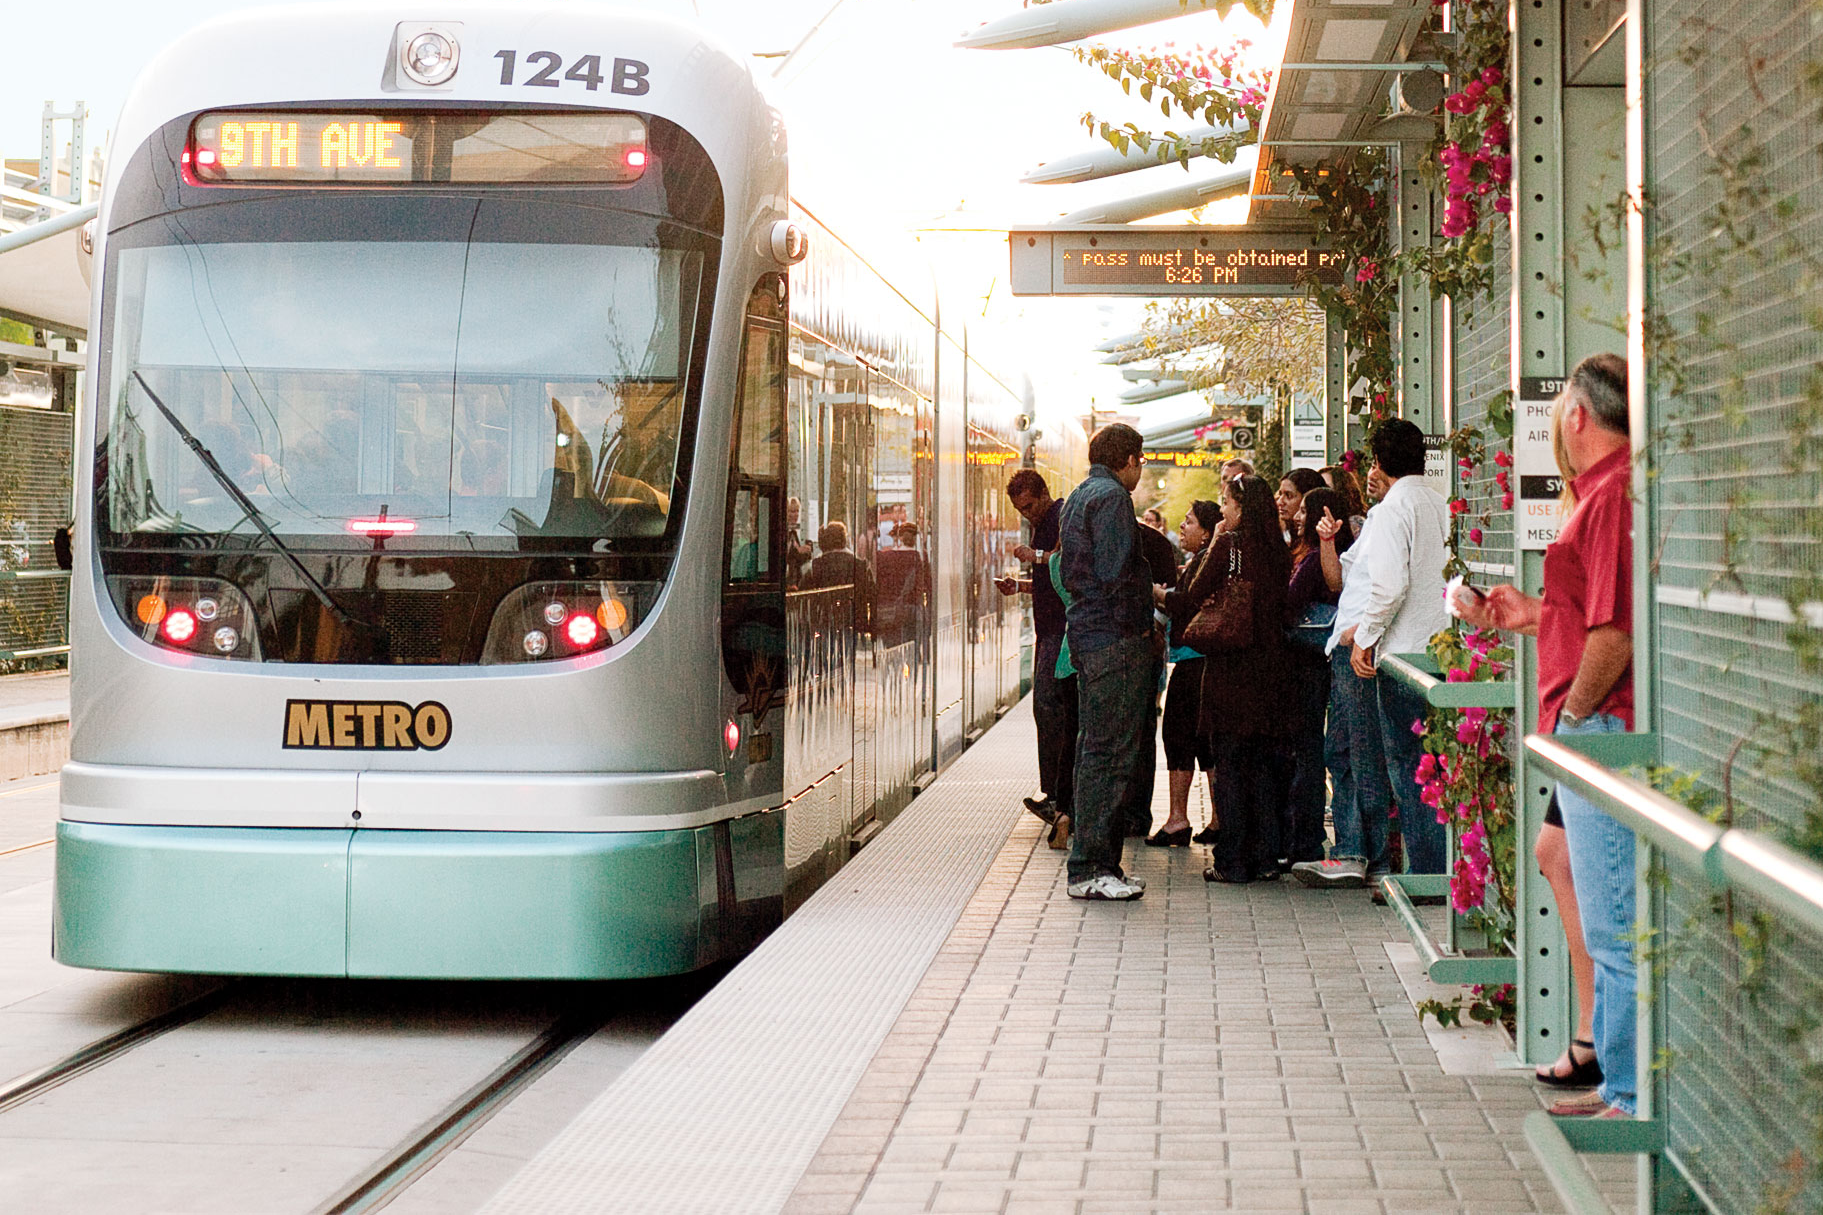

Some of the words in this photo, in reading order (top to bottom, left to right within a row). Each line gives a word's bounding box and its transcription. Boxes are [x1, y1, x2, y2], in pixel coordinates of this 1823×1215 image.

[493, 49, 650, 97] 124B
[220, 122, 298, 167] 9TH
[321, 122, 401, 167] AVE
[1082, 253, 1129, 266] pass
[1139, 249, 1183, 266] must
[1193, 249, 1216, 266] be
[1227, 249, 1308, 266] obtained
[1165, 267, 1203, 283] 6:26
[1213, 267, 1238, 283] PM
[1527, 504, 1552, 516] USE
[285, 701, 450, 749] METRO
